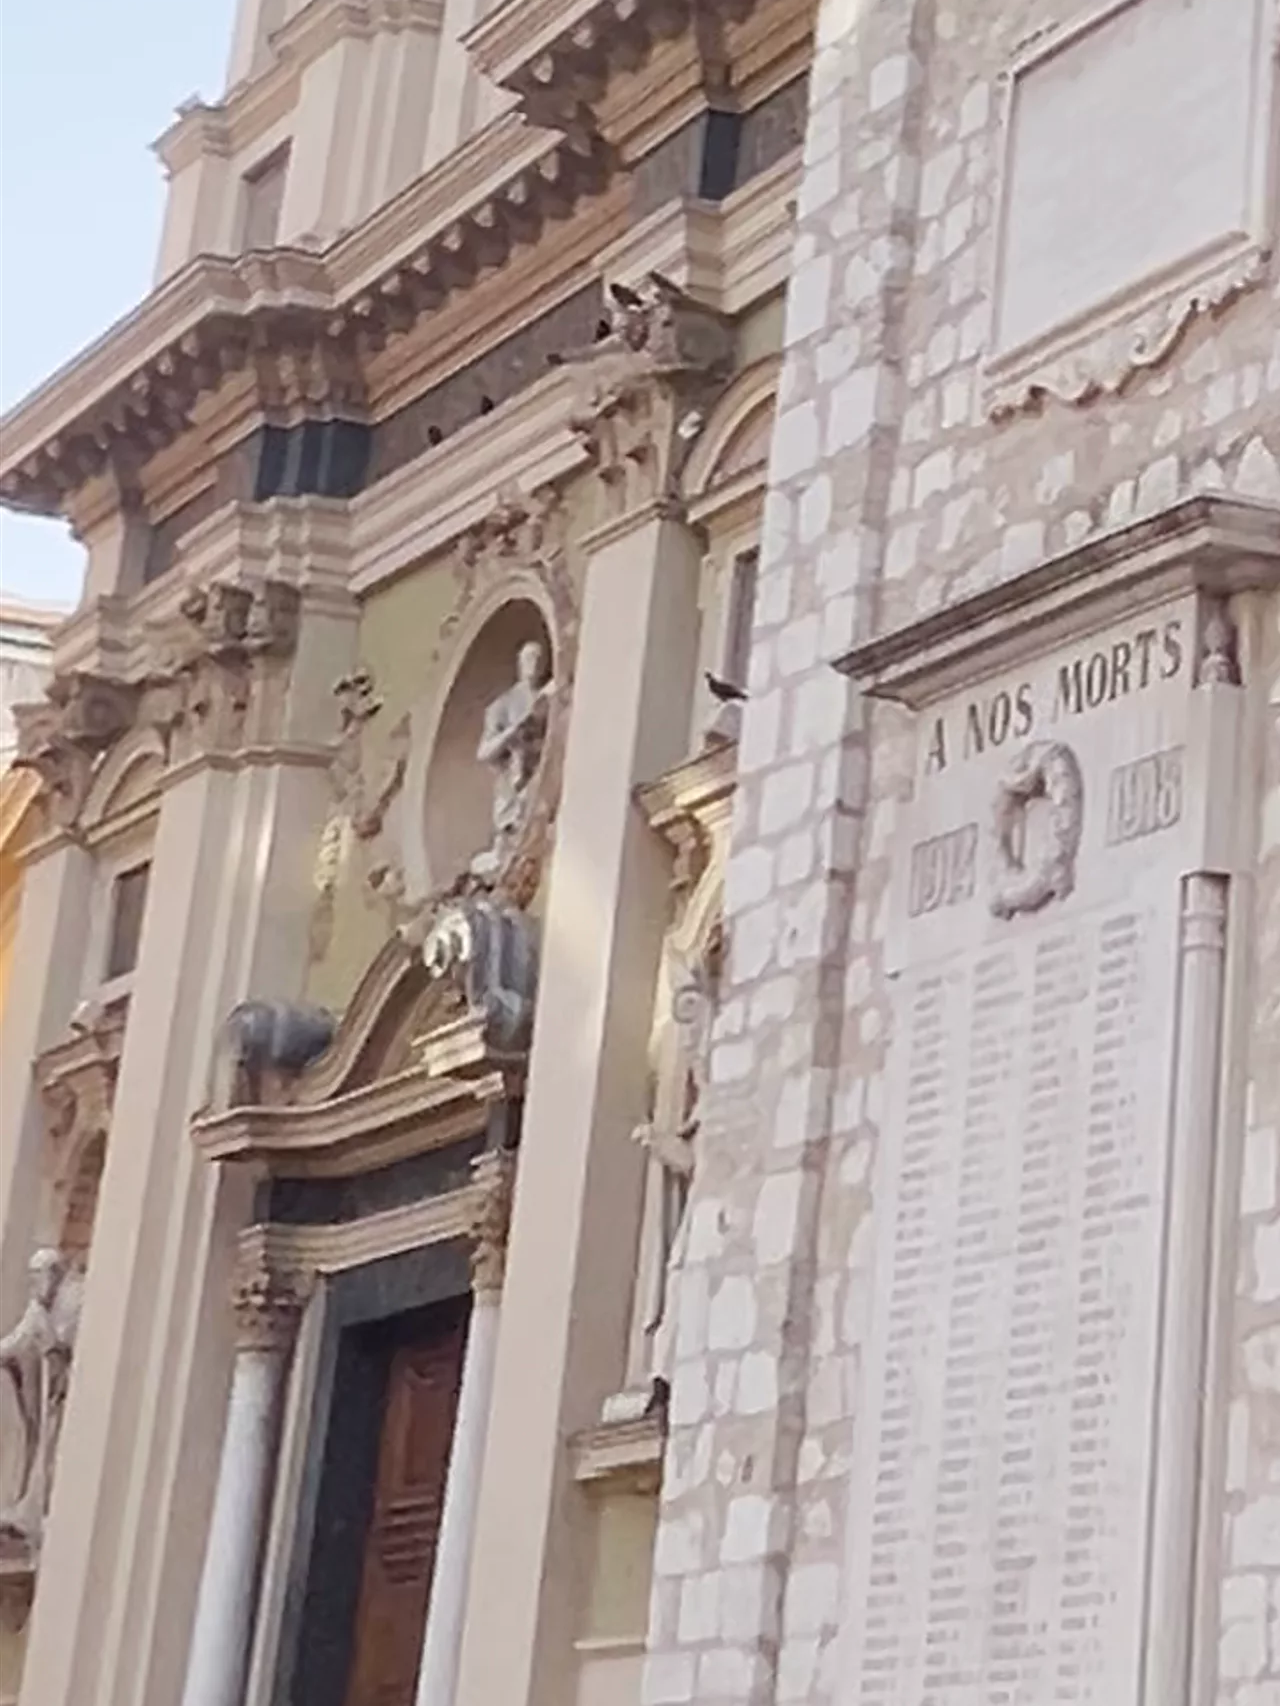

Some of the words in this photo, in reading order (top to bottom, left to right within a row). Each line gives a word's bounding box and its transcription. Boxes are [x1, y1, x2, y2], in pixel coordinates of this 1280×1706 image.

[924, 717, 946, 775] A
[963, 682, 1033, 760] NOS
[1051, 620, 1182, 724] MORTS
